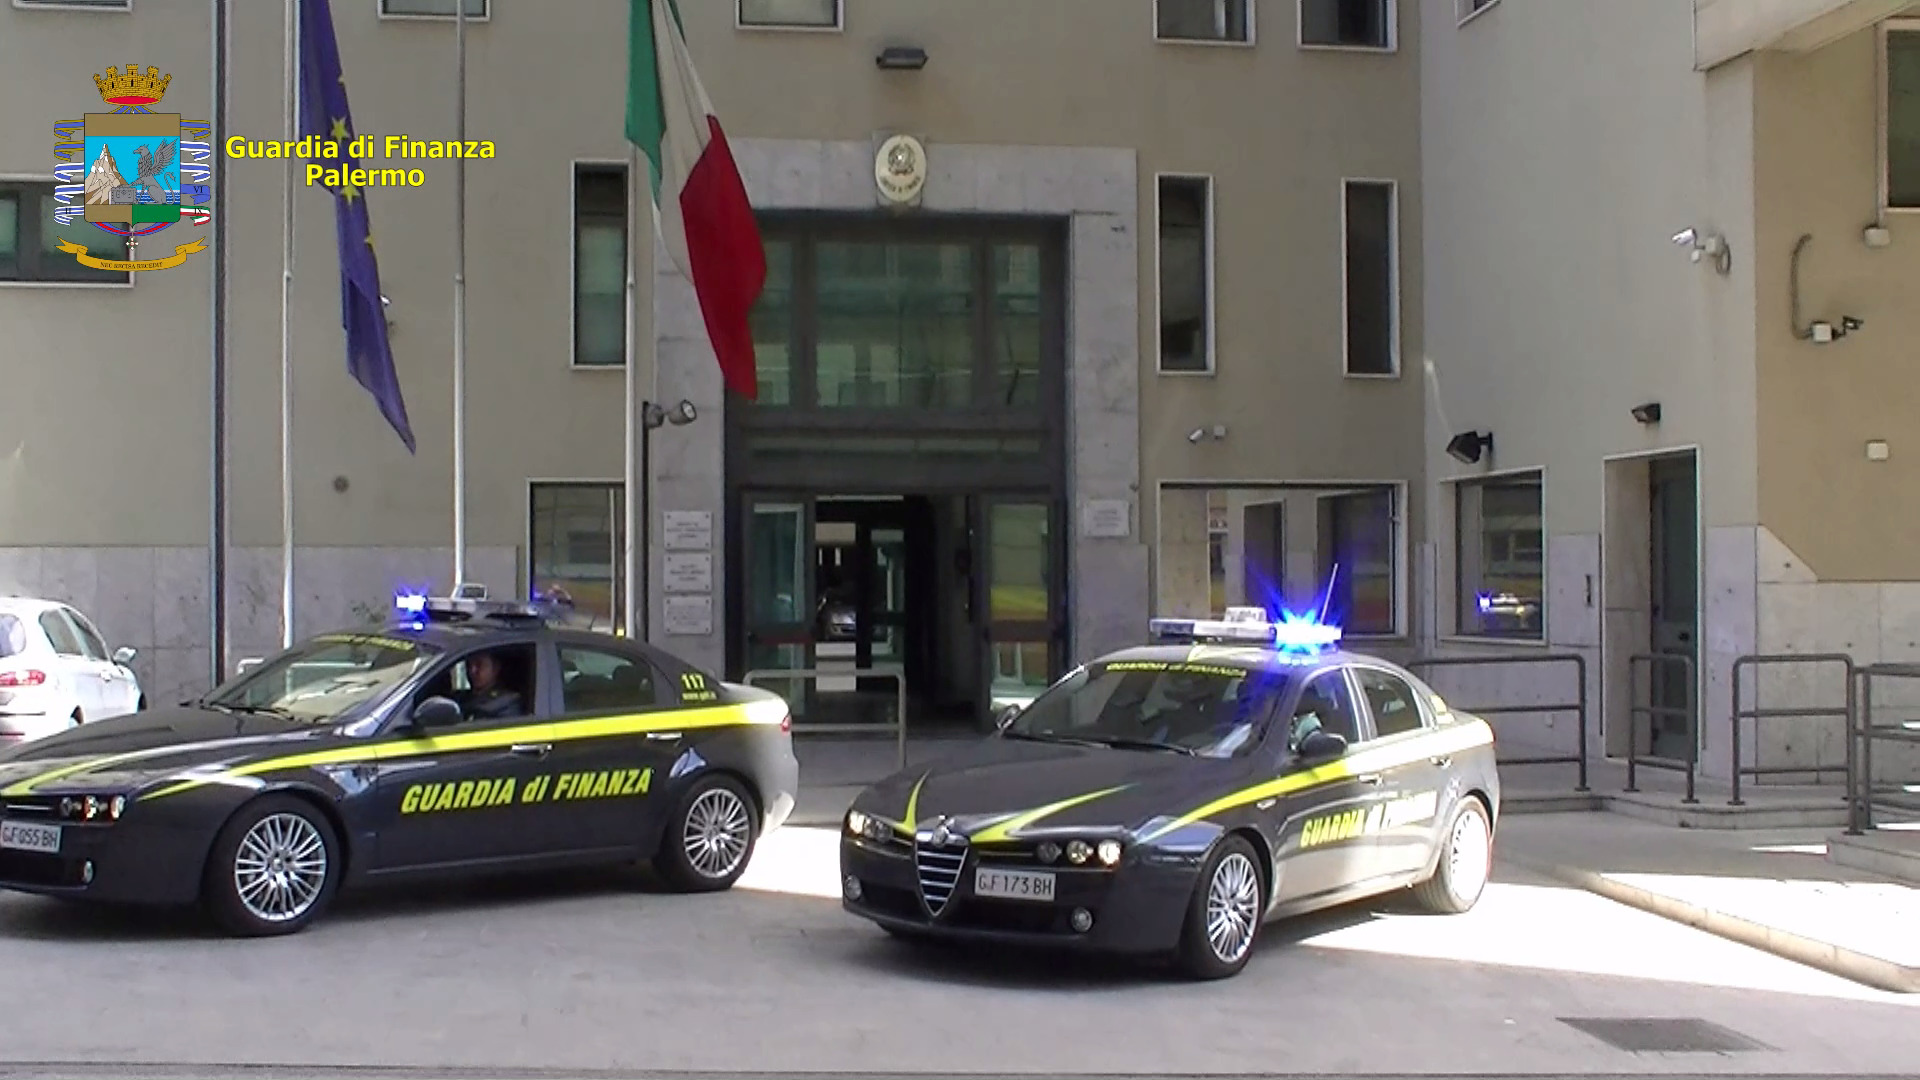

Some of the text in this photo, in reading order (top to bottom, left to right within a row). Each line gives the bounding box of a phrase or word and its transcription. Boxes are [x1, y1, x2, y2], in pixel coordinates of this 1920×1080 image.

[681, 672, 705, 690] 117
[401, 767, 653, 814] GUARDIA di FINANZA
[1300, 808, 1366, 848] GUARDIA
[41, 830, 59, 849] BH
[1003, 874, 1030, 894] 173
[1033, 877, 1053, 896] BH
